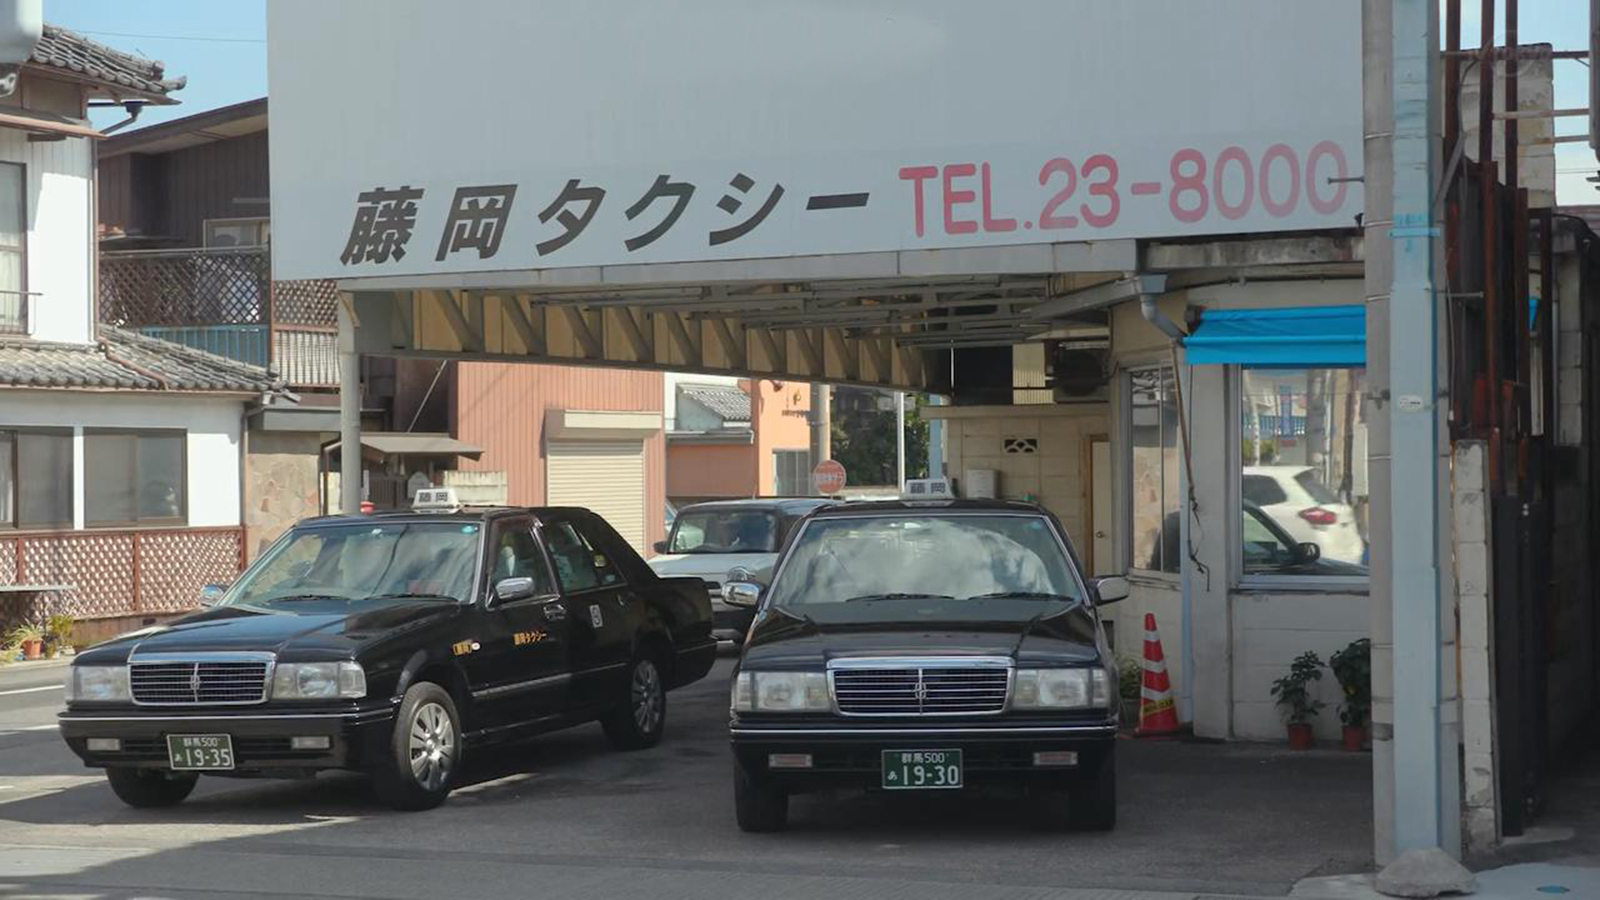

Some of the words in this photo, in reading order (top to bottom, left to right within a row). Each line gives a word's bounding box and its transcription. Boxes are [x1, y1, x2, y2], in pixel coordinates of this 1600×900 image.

[898, 139, 1348, 238] TEL.23-8000
[340, 173, 870, 266] 藤岡タクシー
[185, 749, 231, 767] 19-35
[903, 765, 959, 786] 19-30
